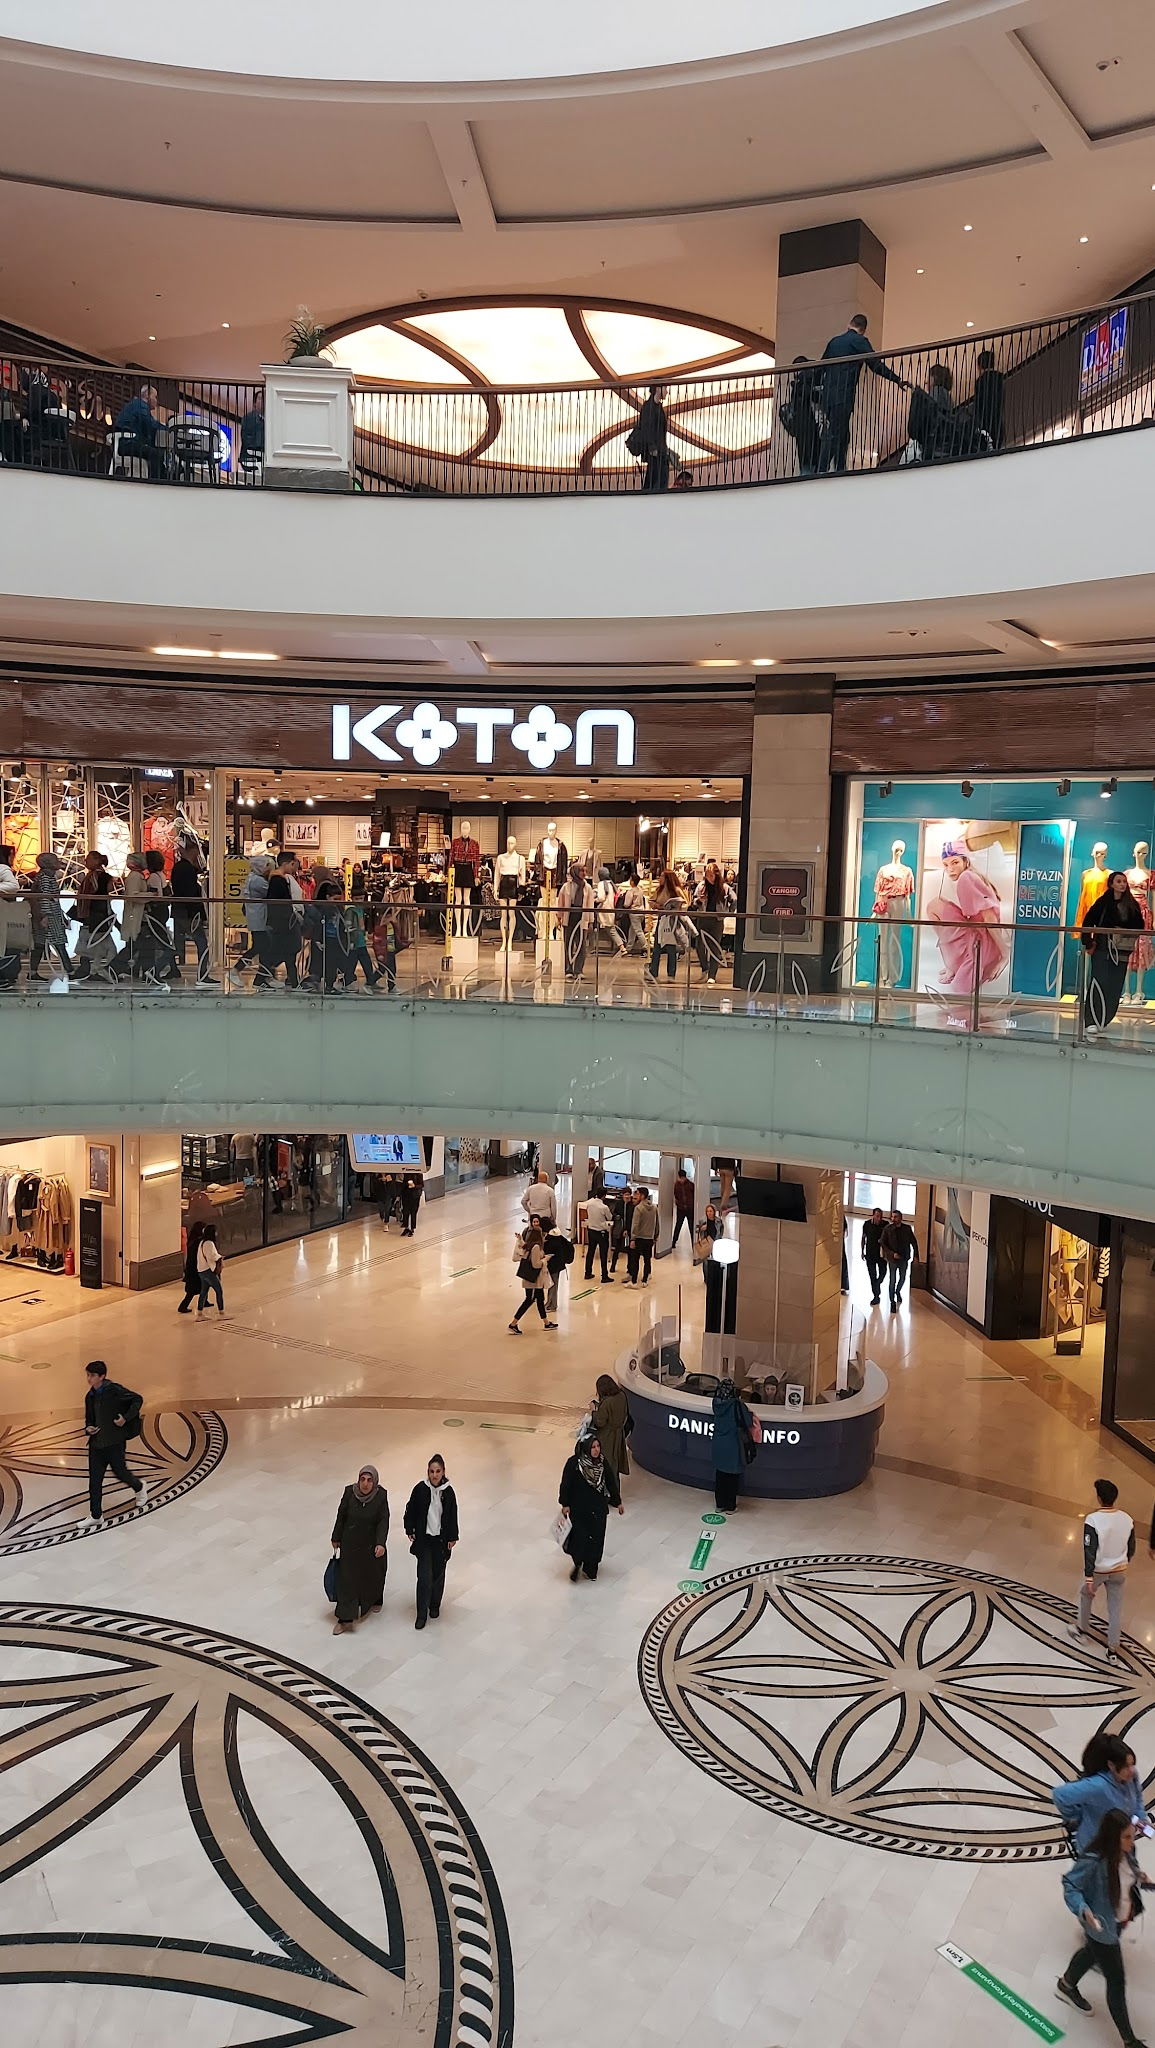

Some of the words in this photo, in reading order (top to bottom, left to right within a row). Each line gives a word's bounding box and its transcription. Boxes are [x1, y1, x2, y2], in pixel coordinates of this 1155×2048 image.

[1020, 870, 1034, 881] BU
[1018, 885, 1060, 902] RENG
[1018, 902, 1061, 919] SENSİN
[761, 1429, 801, 1445] NFO
[1031, 2017, 1056, 2037] Sosyal
